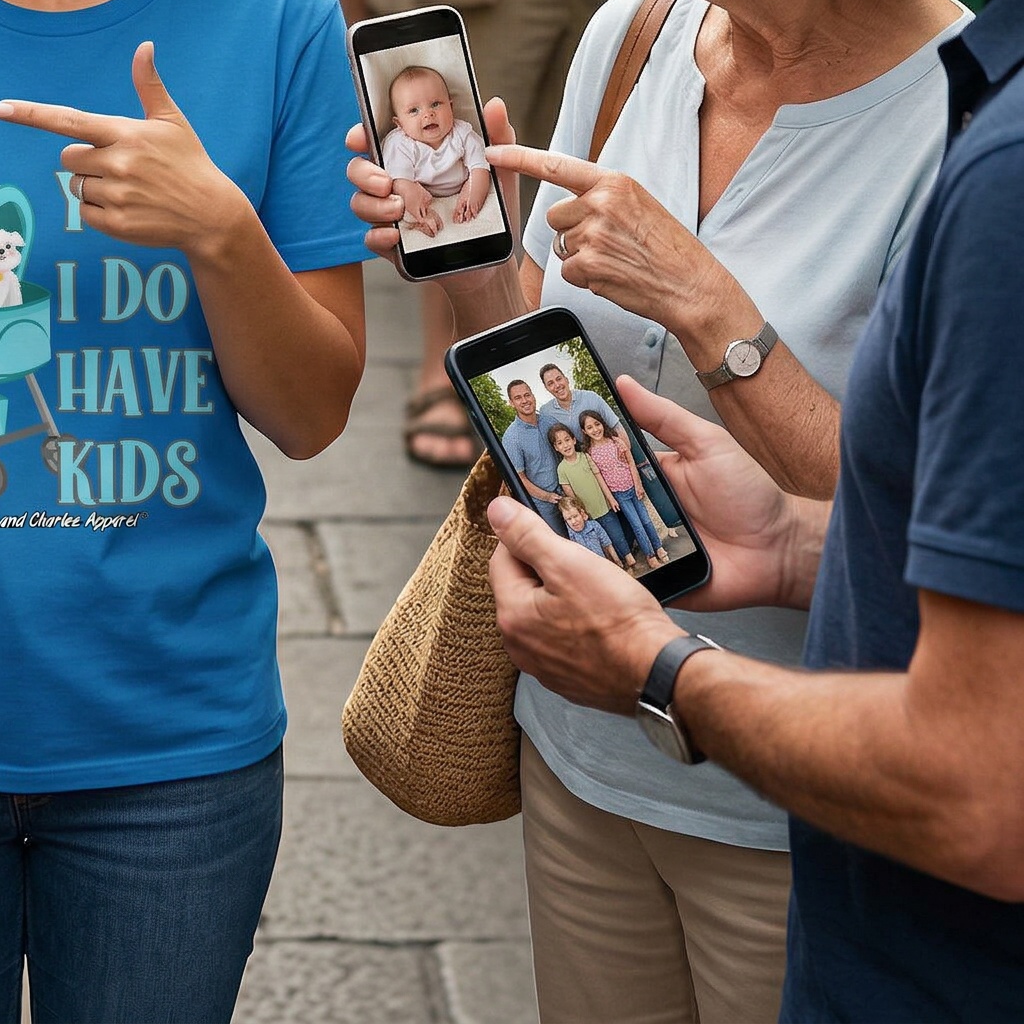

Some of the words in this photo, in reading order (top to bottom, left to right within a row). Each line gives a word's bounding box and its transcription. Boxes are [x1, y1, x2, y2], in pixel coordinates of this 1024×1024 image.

[56, 262, 78, 322] I
[101, 257, 188, 322] DO
[56, 347, 215, 416] HAVE
[56, 439, 201, 506] KIDS
[0, 512, 28, 528] and
